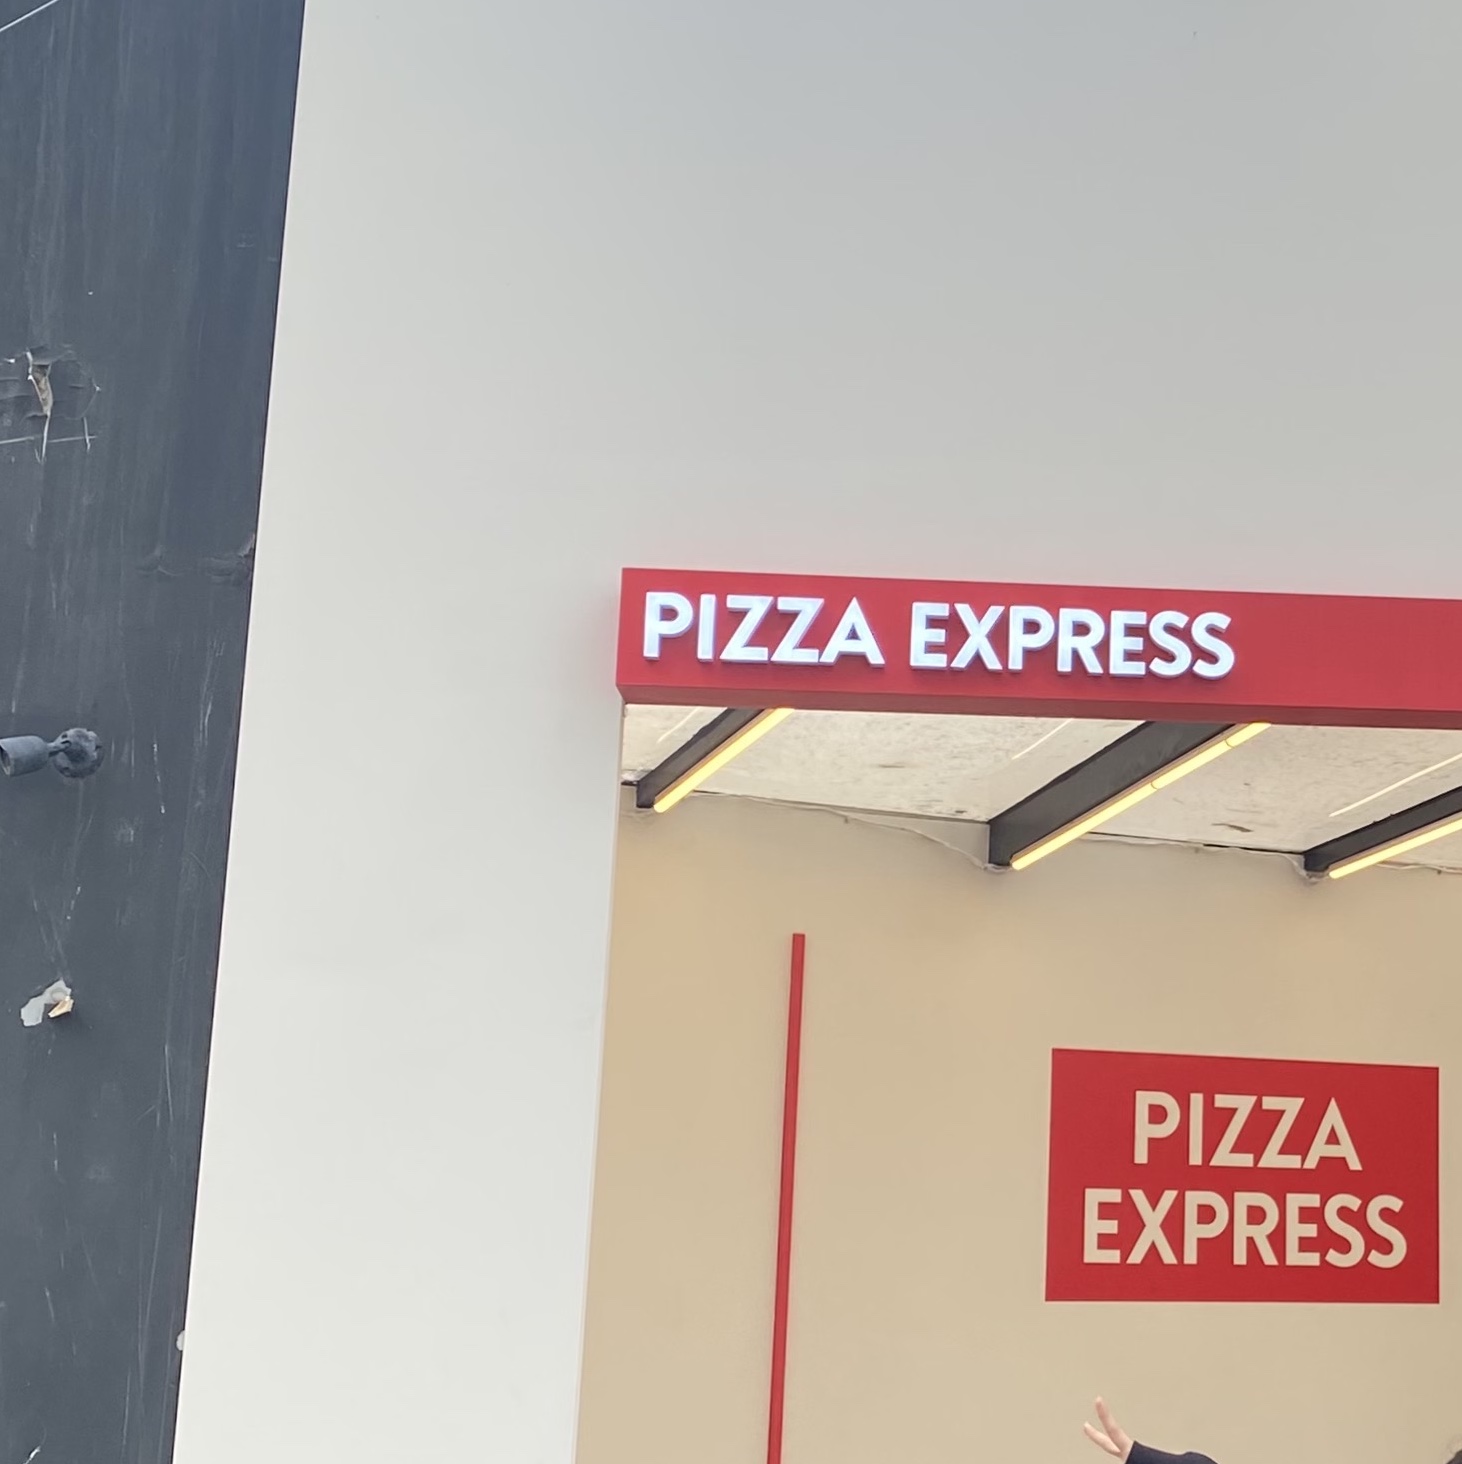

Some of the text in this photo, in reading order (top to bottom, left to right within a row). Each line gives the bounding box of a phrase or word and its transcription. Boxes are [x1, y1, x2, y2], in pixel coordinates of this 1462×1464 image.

[642, 591, 1236, 682] PIZZA EXPRESS
[1133, 1089, 1364, 1172] PIZZA
[1083, 1187, 1408, 1269] EXPRESS
